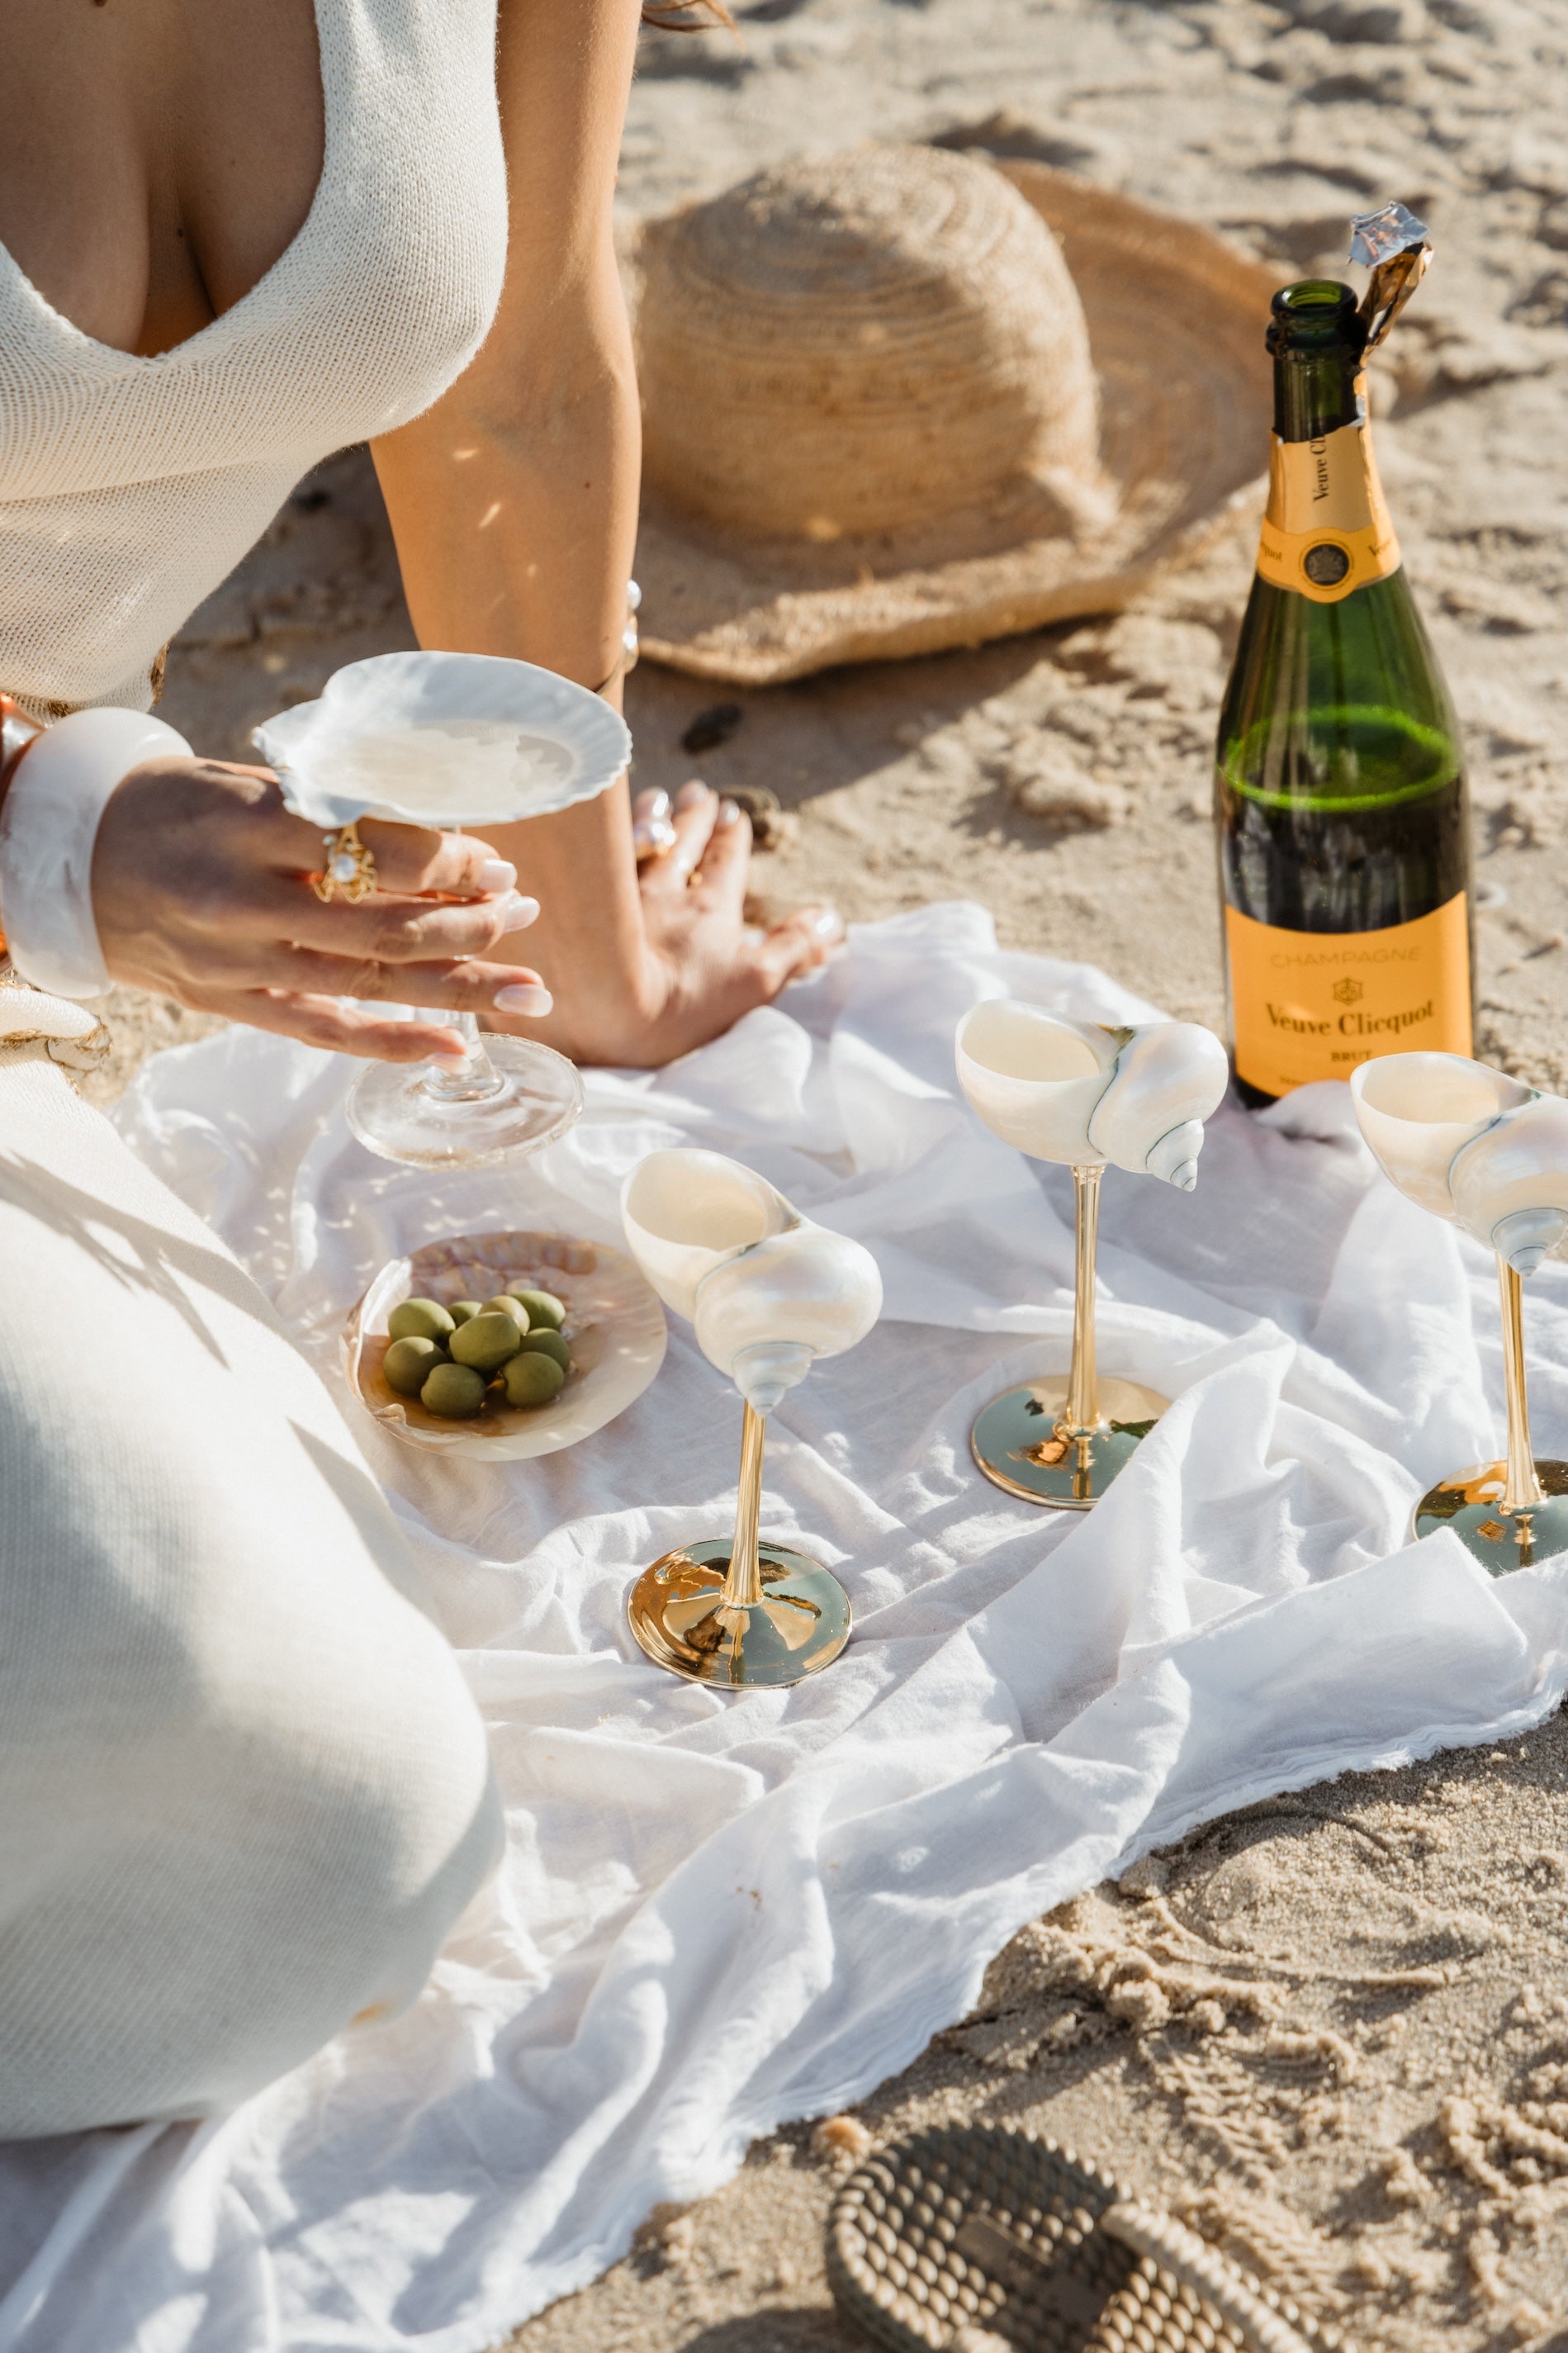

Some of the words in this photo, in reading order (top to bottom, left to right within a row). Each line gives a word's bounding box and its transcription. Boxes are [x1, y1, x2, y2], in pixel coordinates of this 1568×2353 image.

[1311, 458, 1330, 502] Veuve
[1270, 946, 1421, 969] CHAMPAGNE
[1266, 1002, 1330, 1035] Veuve
[1338, 1000, 1433, 1036] Clicquot
[1330, 1050, 1372, 1063] BRUT
